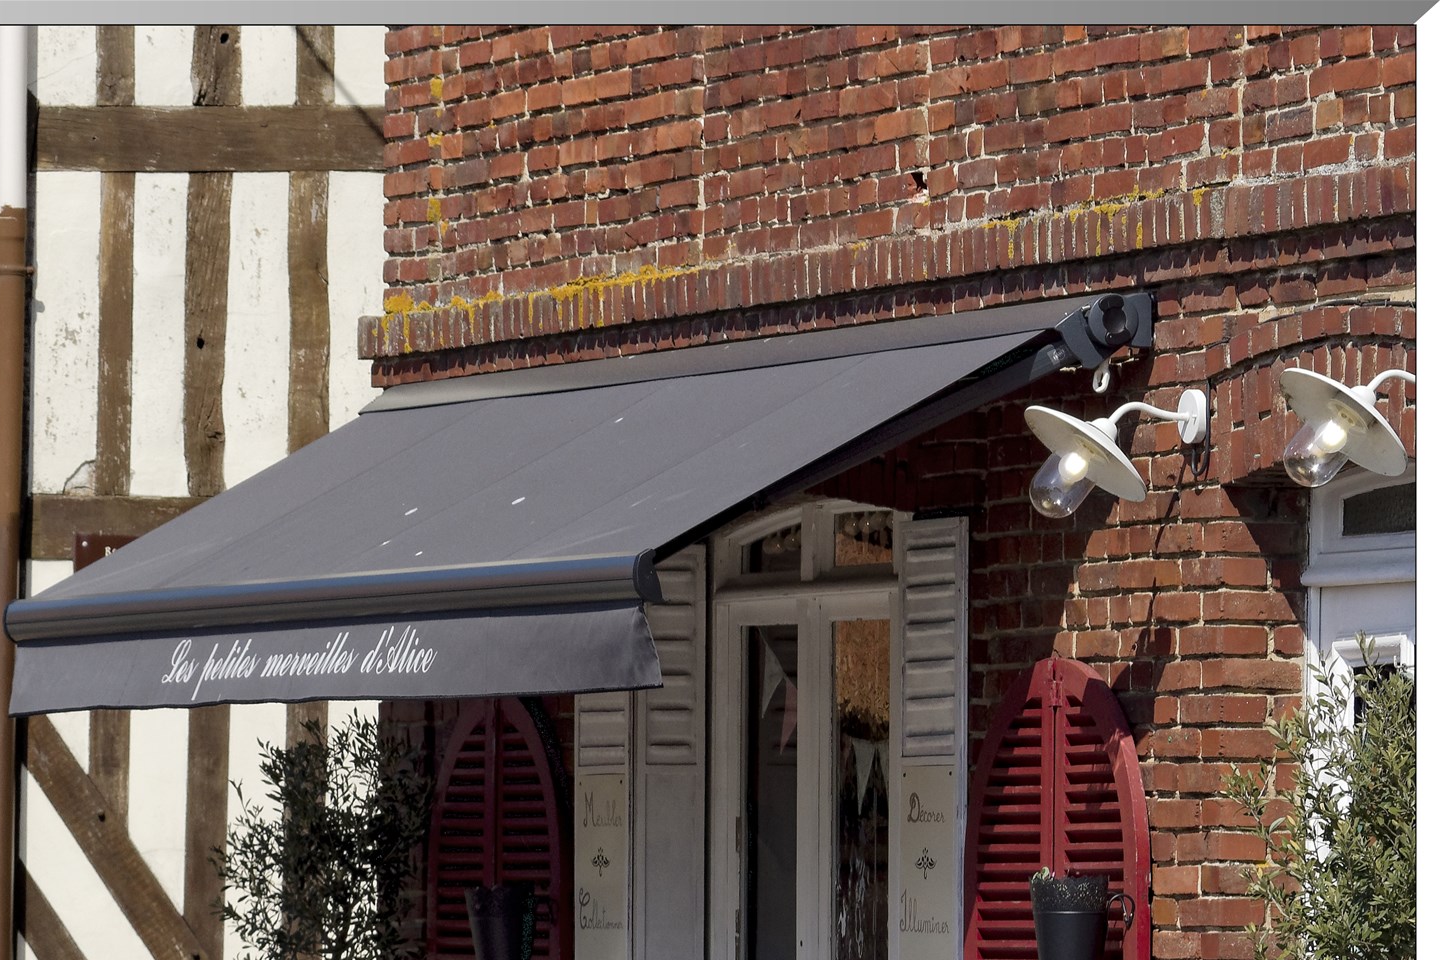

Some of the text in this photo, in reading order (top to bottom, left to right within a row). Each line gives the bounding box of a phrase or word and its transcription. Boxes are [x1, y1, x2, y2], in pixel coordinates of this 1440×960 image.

[161, 624, 438, 701] Les petites merveilles d'Alice
[583, 791, 623, 828] Meubler
[899, 888, 950, 934] Illuminer
